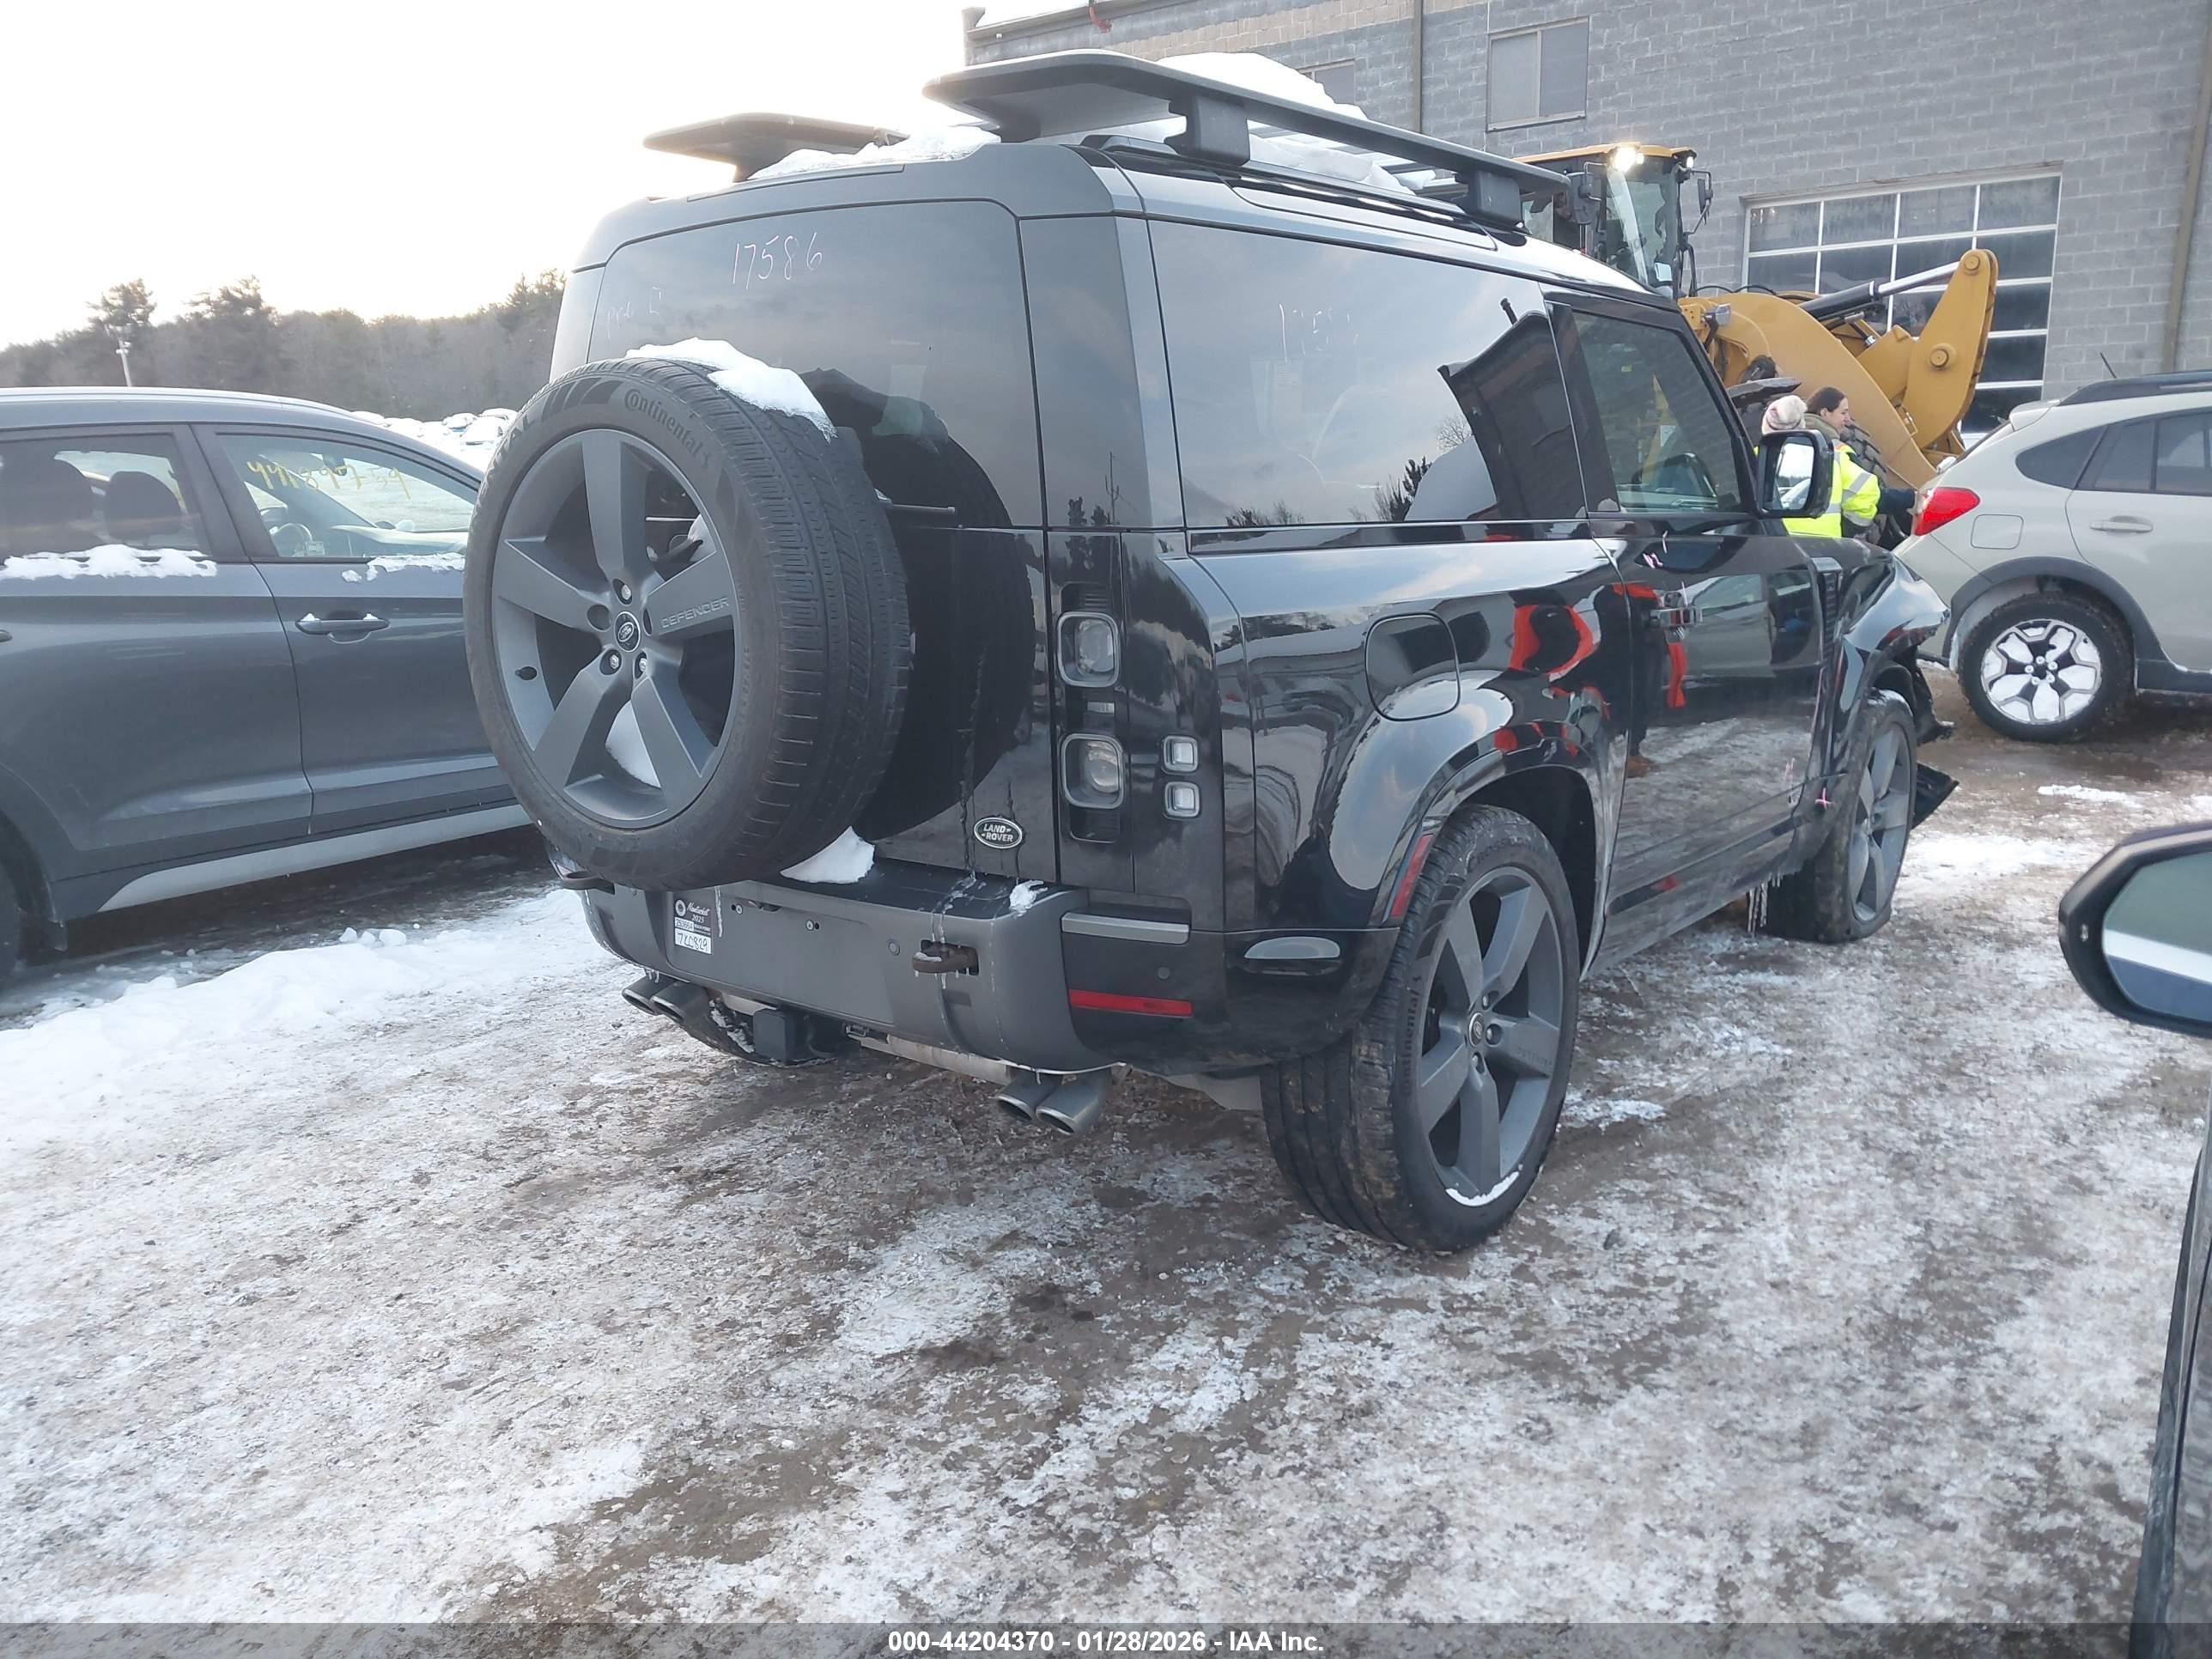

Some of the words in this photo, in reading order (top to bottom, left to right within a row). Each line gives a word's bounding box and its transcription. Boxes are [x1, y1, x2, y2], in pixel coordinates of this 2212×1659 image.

[732, 232, 823, 289] 17586
[624, 388, 703, 457] Continental
[661, 597, 729, 629] DEFENDER
[983, 823, 1006, 834] LAND
[986, 832, 1013, 842] ROVER
